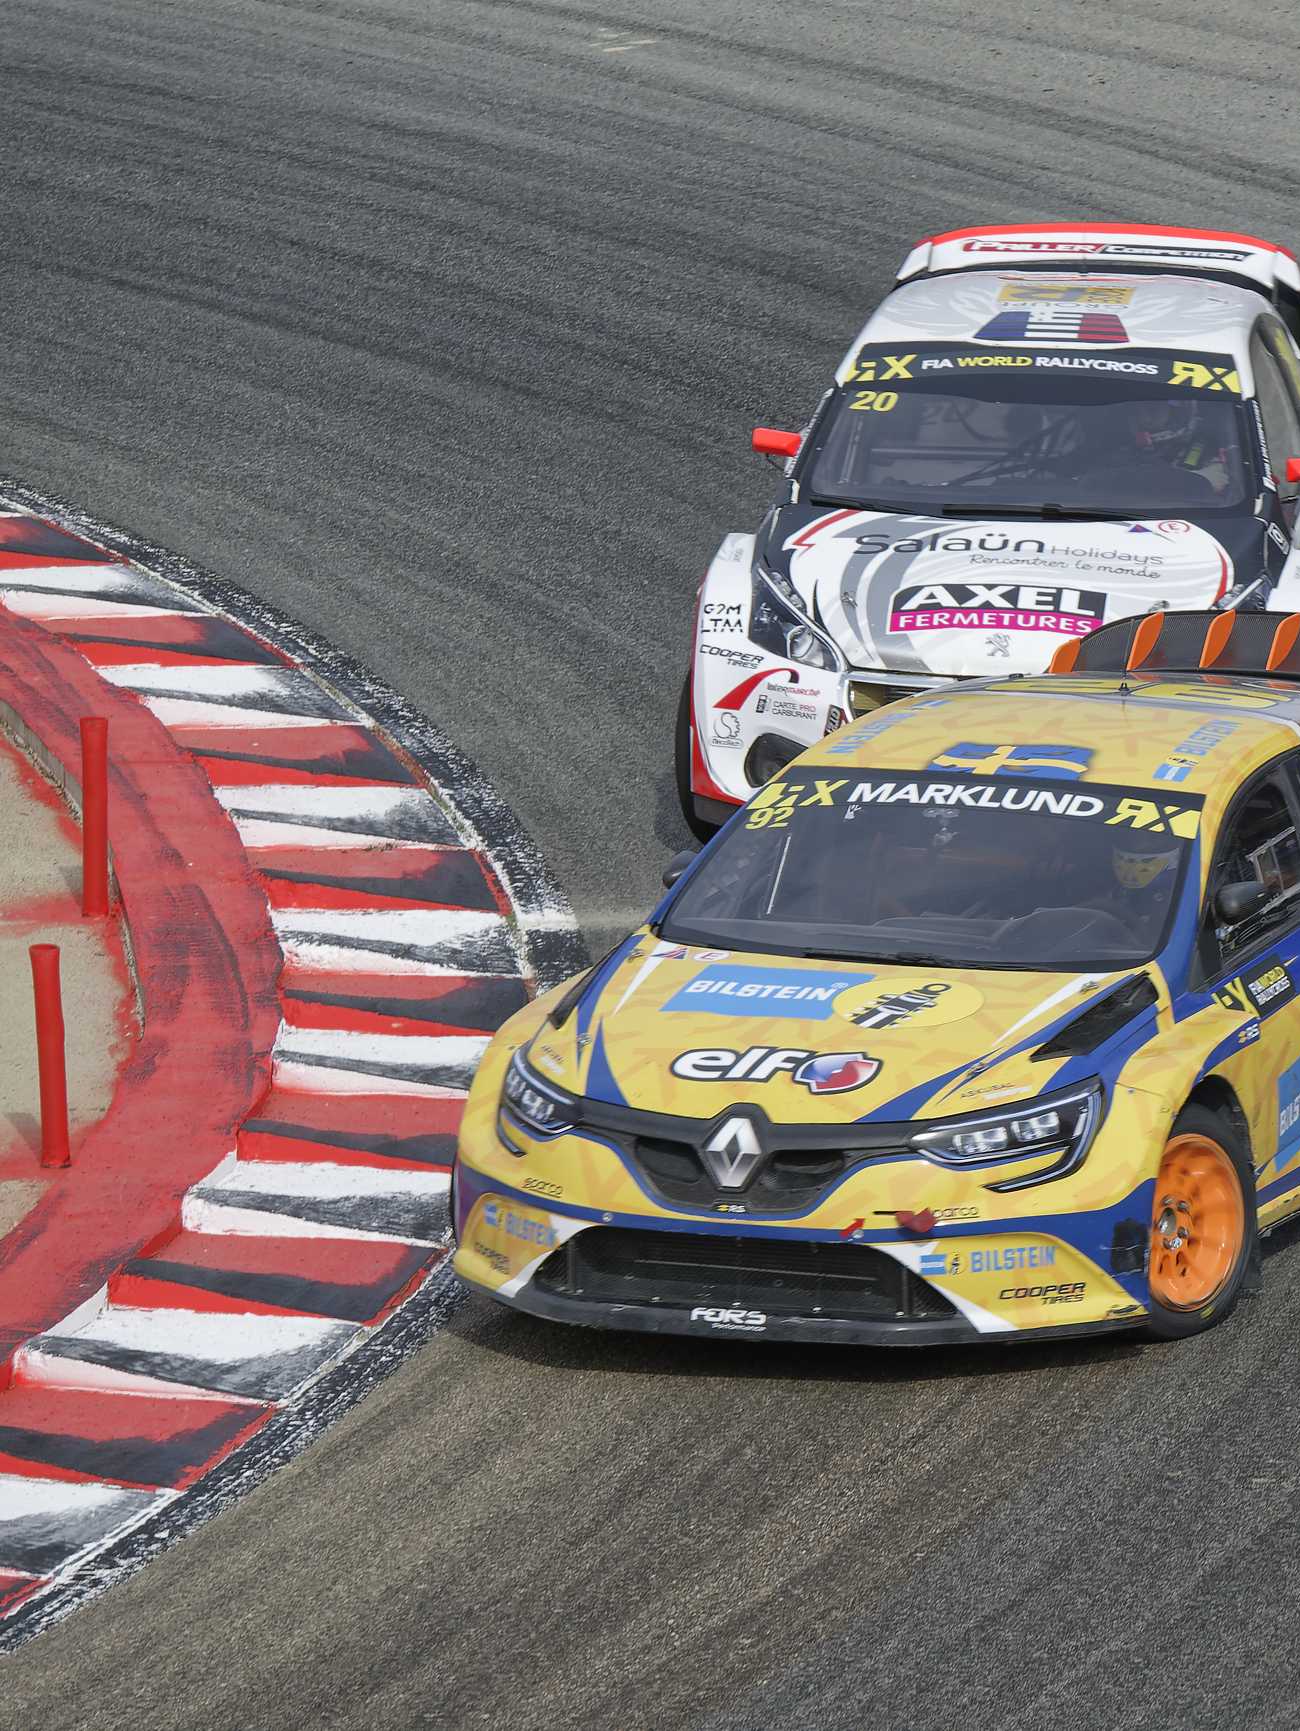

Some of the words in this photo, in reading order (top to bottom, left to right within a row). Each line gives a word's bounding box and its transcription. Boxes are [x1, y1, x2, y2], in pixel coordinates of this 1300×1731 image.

[921, 358, 954, 370] FIA
[957, 355, 1033, 368] WORLD
[1035, 356, 1159, 375] RALLYCROSS
[849, 390, 899, 412] 20
[853, 532, 1045, 555] Salaün
[1051, 545, 1164, 566] Holidays
[969, 553, 1067, 569] Rencontrer
[1075, 559, 1093, 570] le
[1097, 565, 1161, 579] monde
[900, 585, 1095, 617] AXEL
[899, 612, 1092, 633] FERMETURES
[699, 643, 765, 664] COOPER
[728, 658, 758, 670] TIRES
[771, 708, 817, 721] CARBURANT
[773, 700, 798, 711] CARTE
[799, 704, 817, 713] PRO
[847, 782, 1105, 819] MARKLUND
[745, 806, 795, 830] 92
[684, 980, 837, 1002] BILSTEIN
[671, 1046, 815, 1082] elf
[522, 1177, 563, 1197] sparco
[970, 1245, 1057, 1273] BILSTEIN
[999, 1281, 1087, 1301] COOPER
[1040, 1293, 1085, 1306] TIRES
[690, 1306, 768, 1326] FORS
